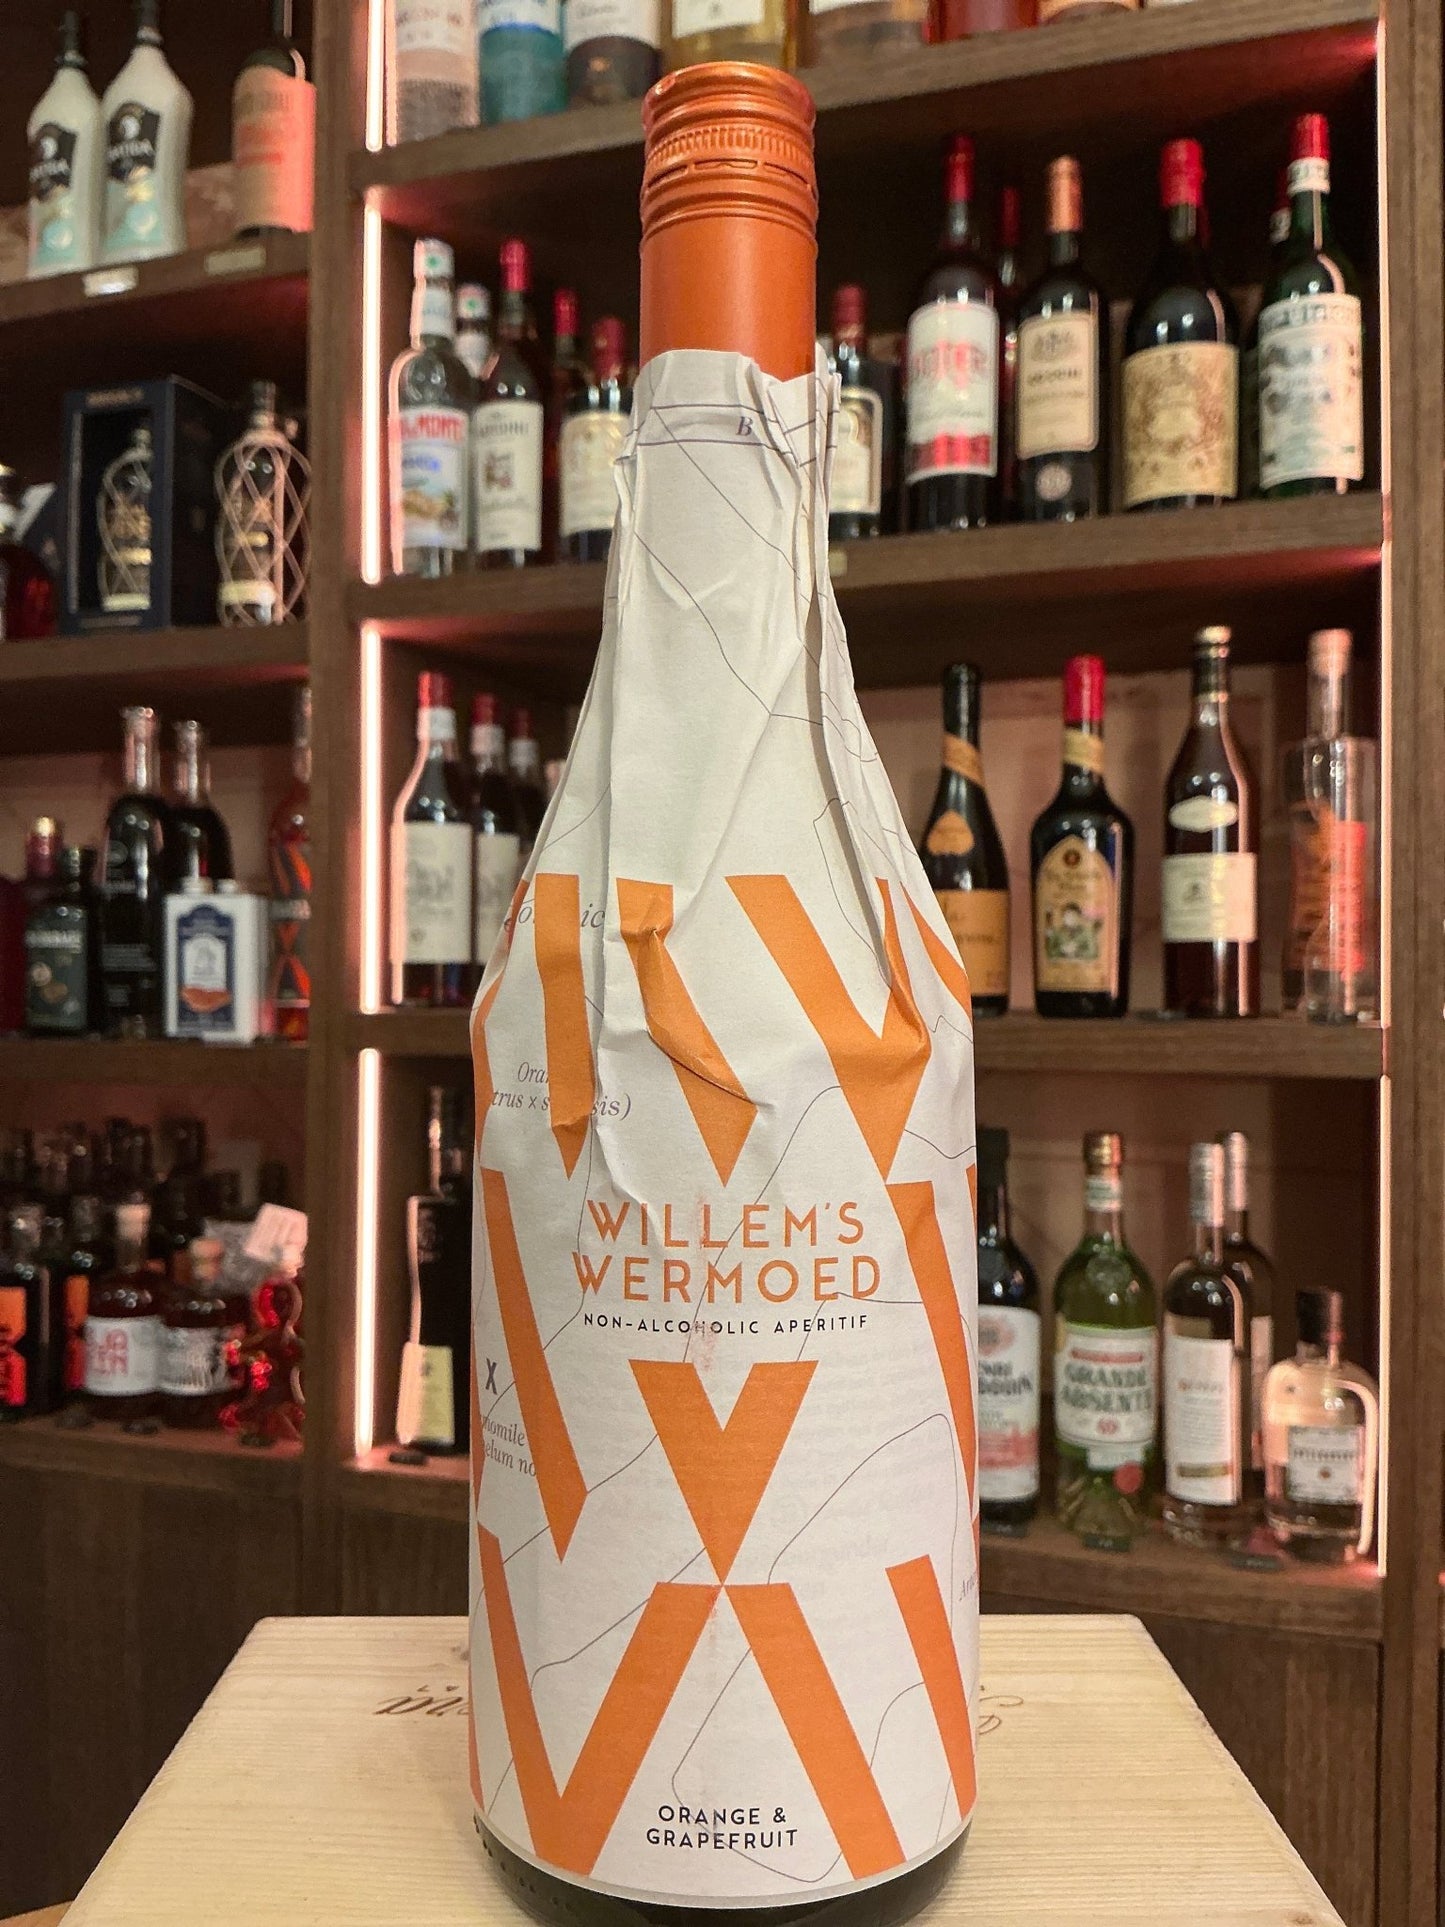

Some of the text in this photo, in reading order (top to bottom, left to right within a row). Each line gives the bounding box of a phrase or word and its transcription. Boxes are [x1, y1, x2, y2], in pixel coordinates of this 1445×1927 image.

[735, 415, 754, 437] B
[517, 1061, 549, 1084] Ora
[491, 1091, 524, 1109] trus
[587, 1199, 864, 1249] WILLEM'S
[572, 1251, 881, 1304] WERMOED
[583, 1313, 868, 1334] NON-ALCOHOLIC APERITIF
[485, 1439, 537, 1477] elum no
[658, 1805, 787, 1825] ORANGE &
[646, 1828, 798, 1850] GRAPEFRUIT
